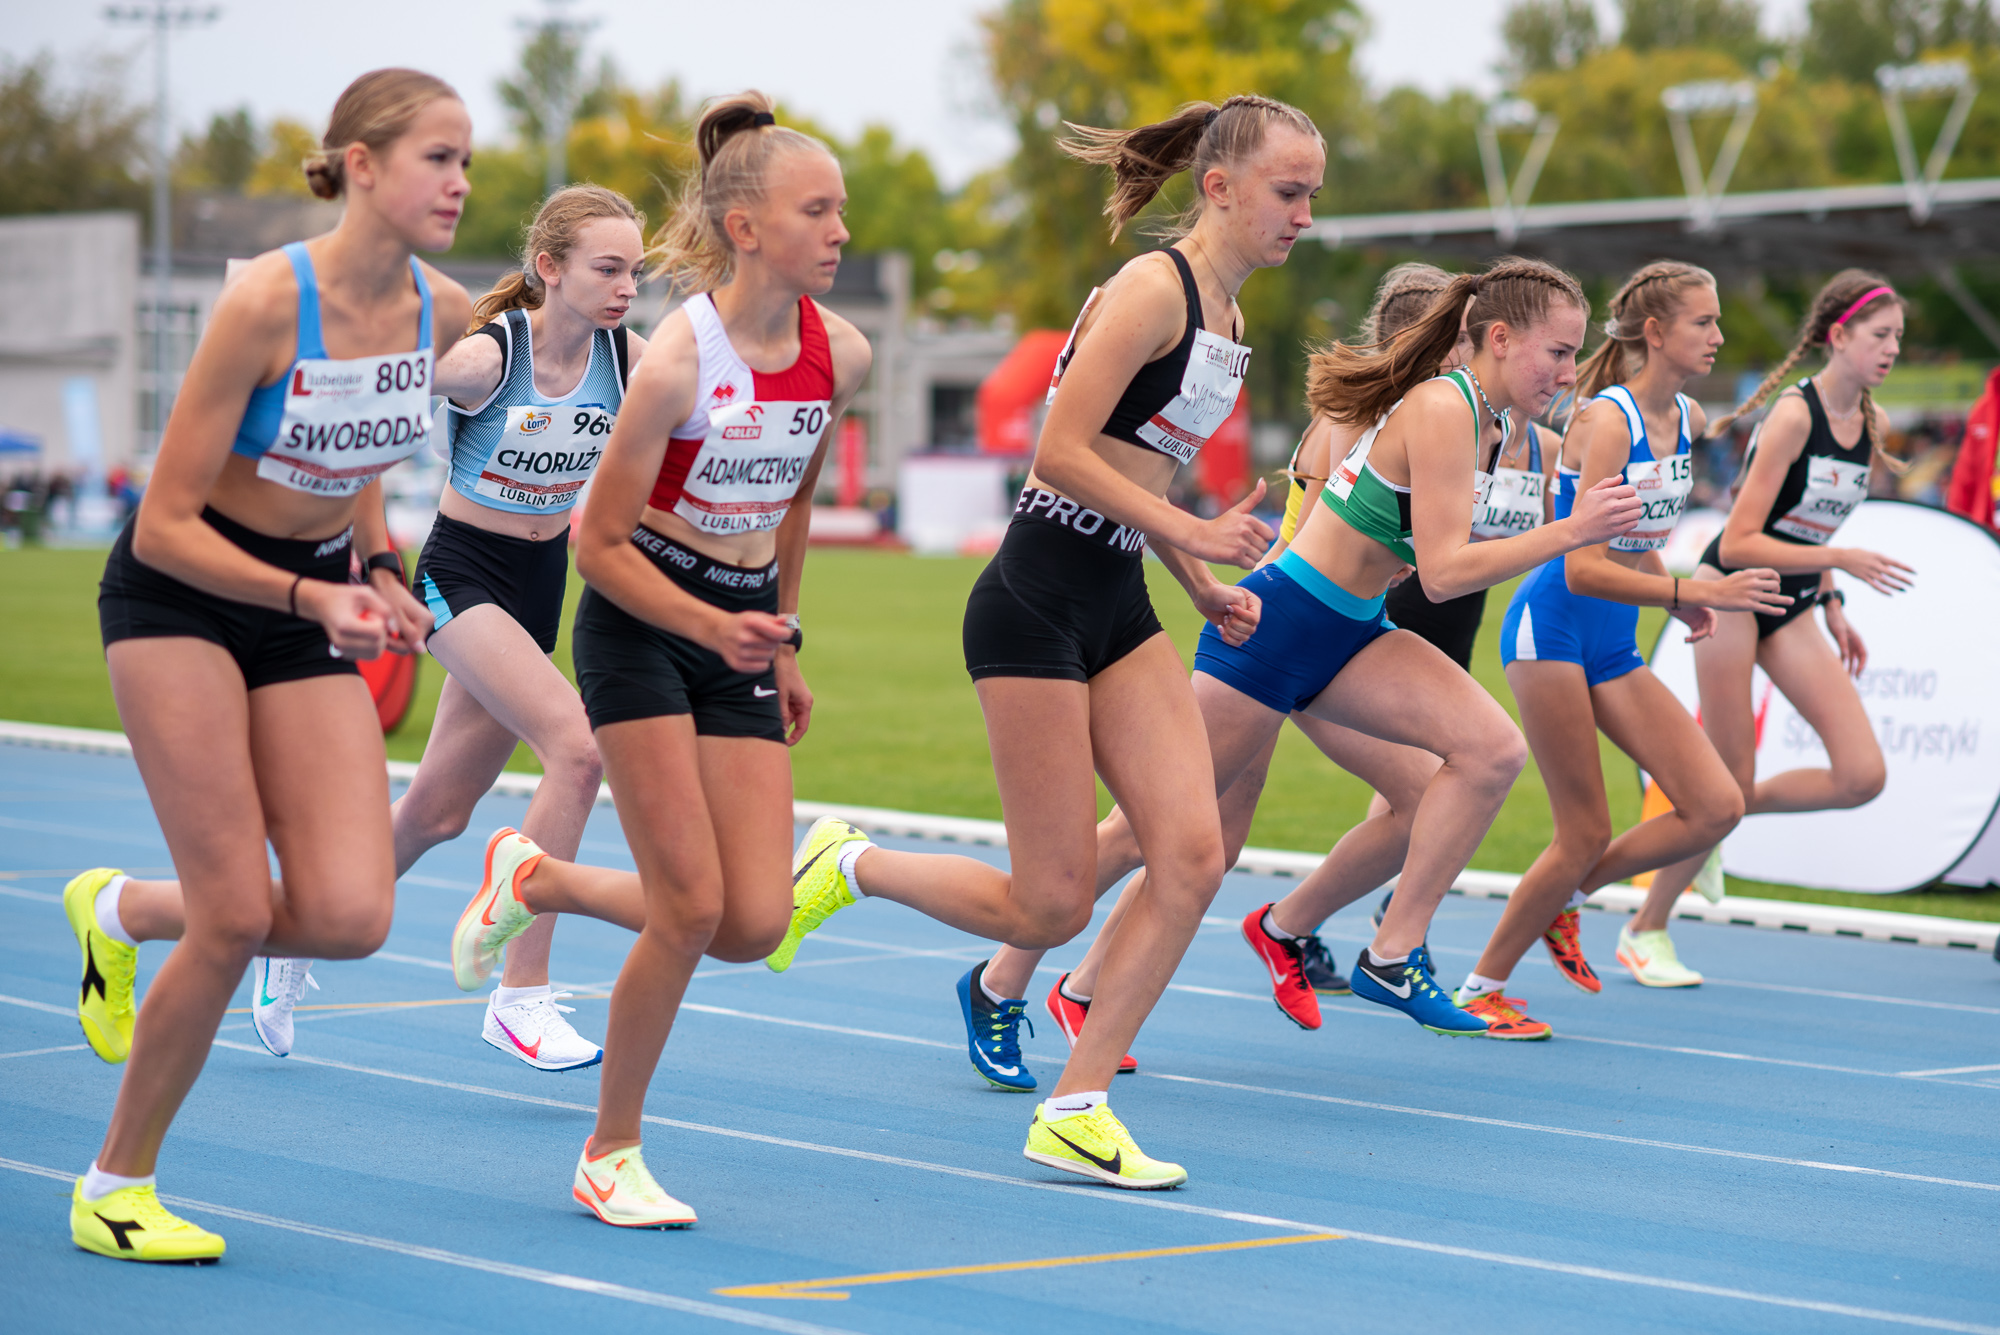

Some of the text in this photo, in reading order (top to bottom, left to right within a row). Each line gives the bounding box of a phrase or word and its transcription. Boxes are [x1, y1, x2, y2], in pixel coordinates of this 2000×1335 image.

[376, 357, 427, 394] 803
[527, 418, 547, 430] LOTTO
[789, 406, 823, 435] 50
[284, 414, 427, 453] SWOBODA
[725, 427, 761, 439] ORLEN
[1158, 435, 1195, 460] LUBLIN
[288, 470, 351, 492] LUBLIN
[499, 486, 547, 506] LUBLIN
[549, 490, 577, 505] 2022
[701, 511, 782, 530] LUBLIN 2022
[1618, 537, 1655, 549] LUBLIN
[659, 545, 698, 570] PRO
[703, 565, 743, 588] NIKE
[739, 572, 766, 588] PRO
